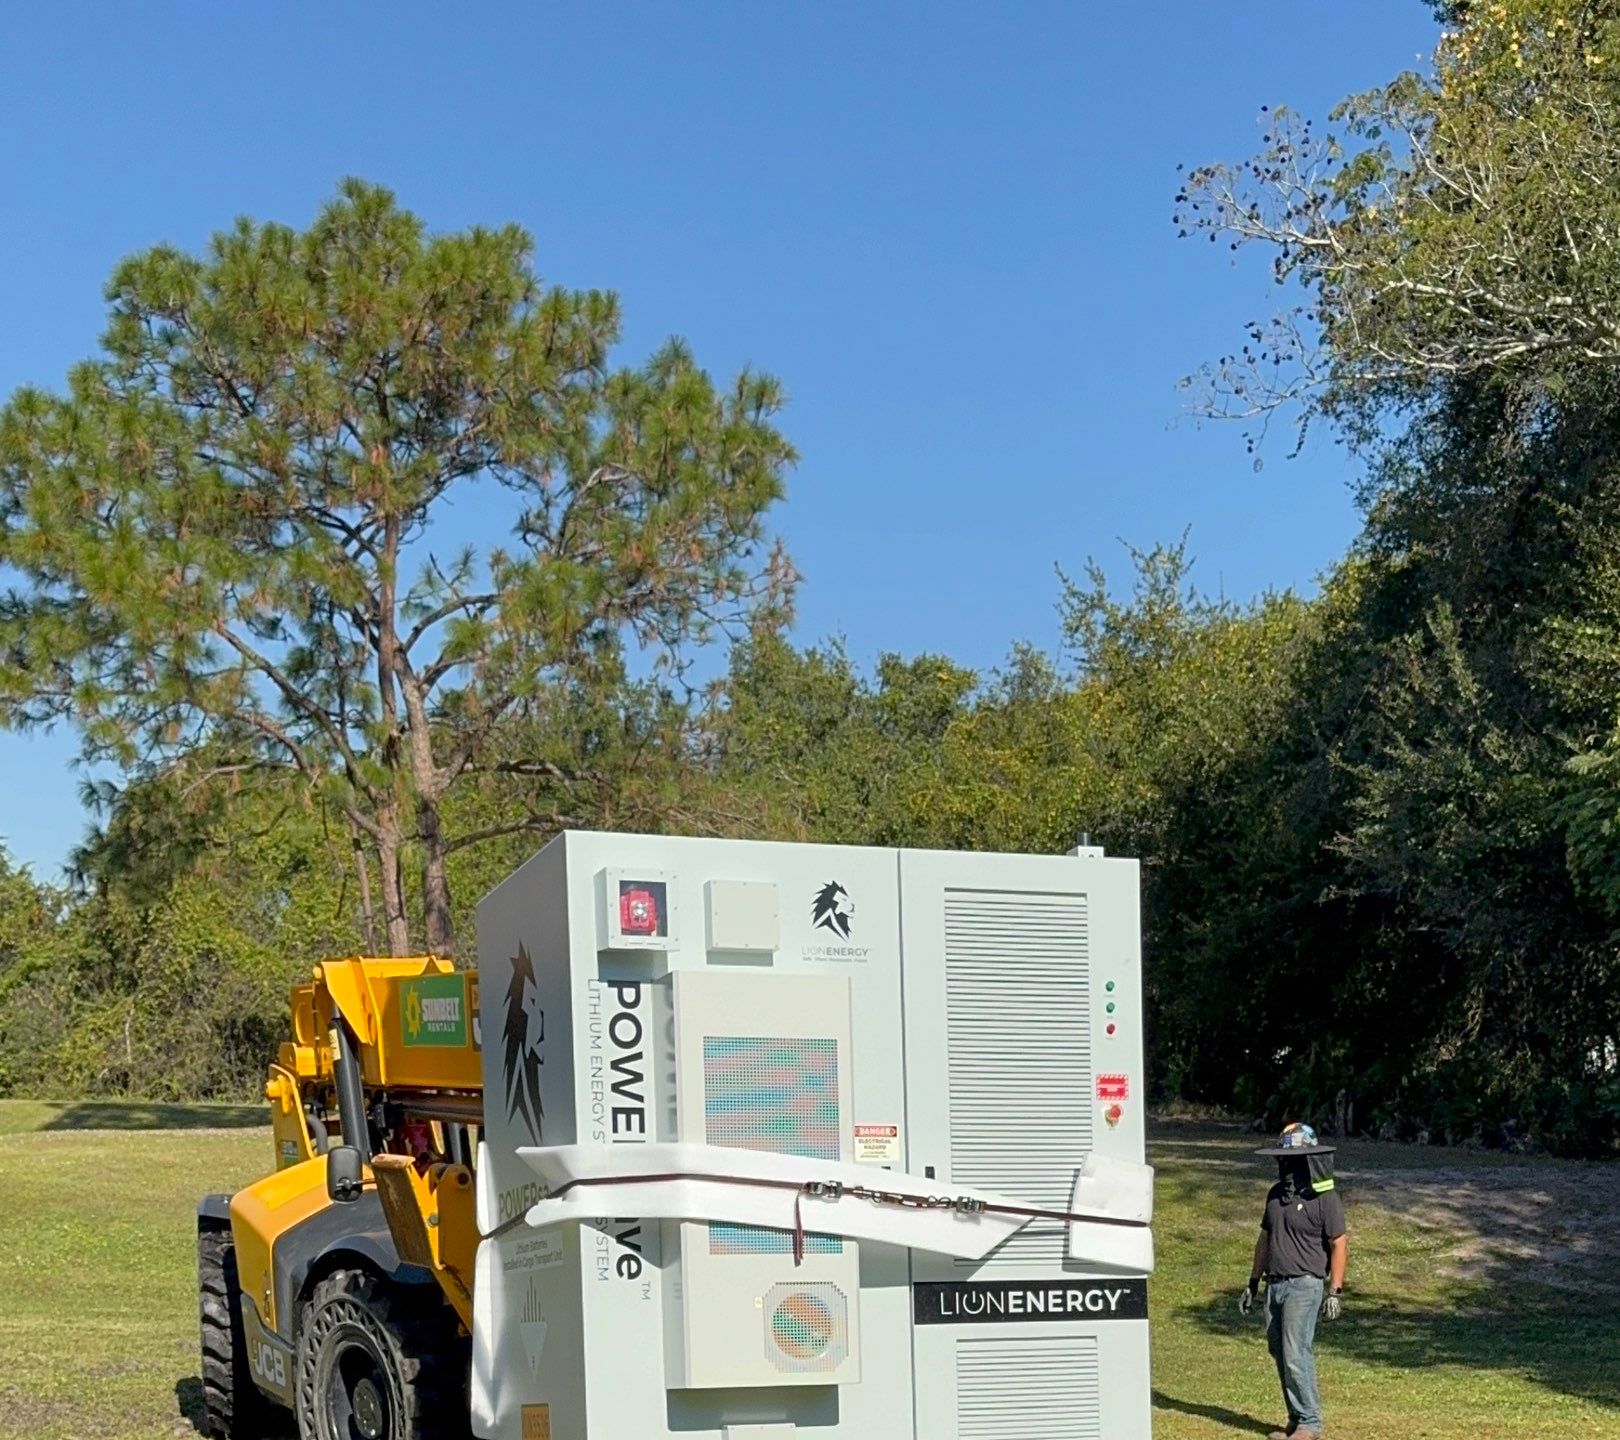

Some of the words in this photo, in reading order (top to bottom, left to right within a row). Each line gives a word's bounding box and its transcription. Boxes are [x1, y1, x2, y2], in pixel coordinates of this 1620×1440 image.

[422, 997, 459, 1021] SUNBELT
[428, 1022, 456, 1033] RENTALS
[588, 979, 603, 1049] LITHIUM
[591, 1055, 605, 1128] ENERGY
[860, 1127, 891, 1136] DANGER
[596, 1217, 609, 1281] SYSTEM
[255, 1341, 287, 1387] JCB
